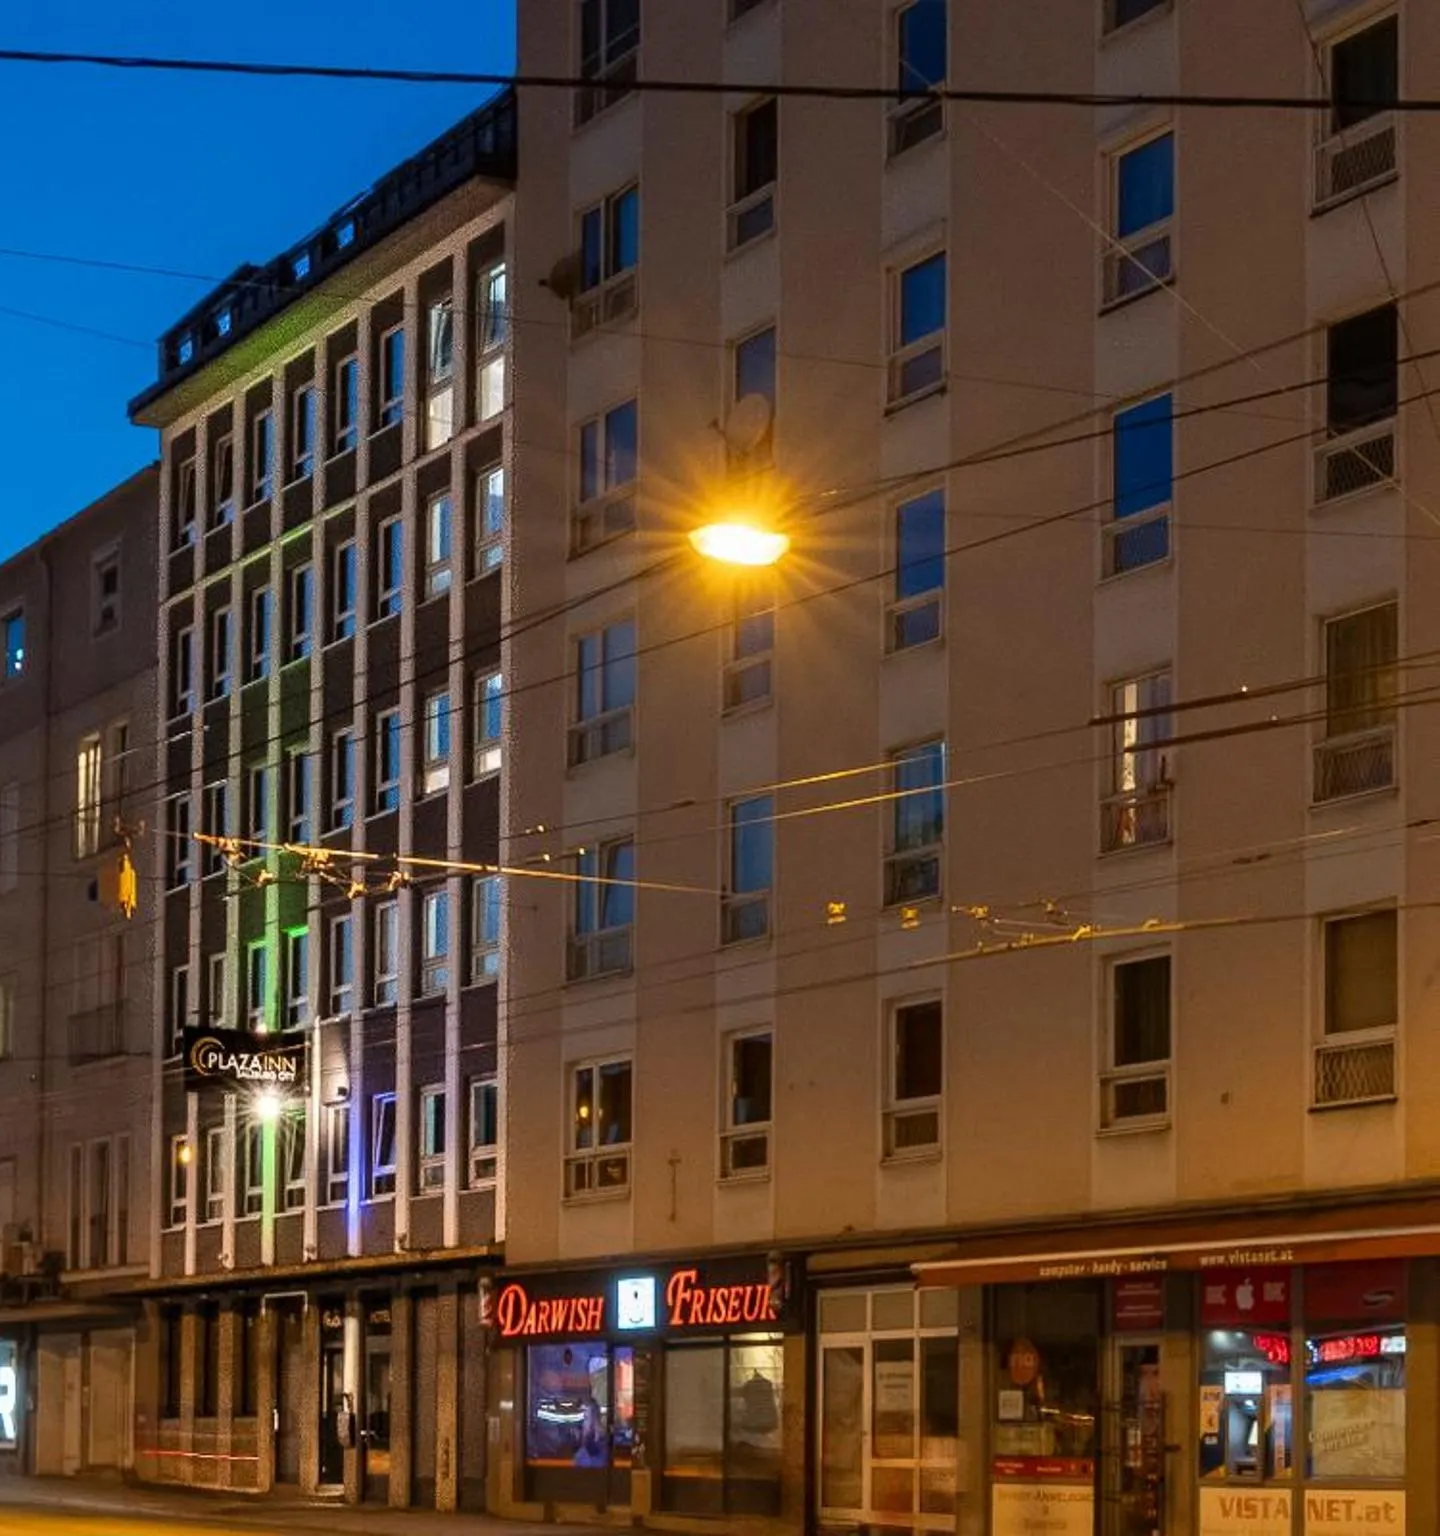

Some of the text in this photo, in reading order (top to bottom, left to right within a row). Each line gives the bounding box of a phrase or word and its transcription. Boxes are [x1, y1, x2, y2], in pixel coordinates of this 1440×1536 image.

[208, 1052, 297, 1073] PLAZA INN
[498, 1269, 776, 1336] DARWISH FRISEUR
[1220, 1496, 1396, 1522] VISTA NET.at
